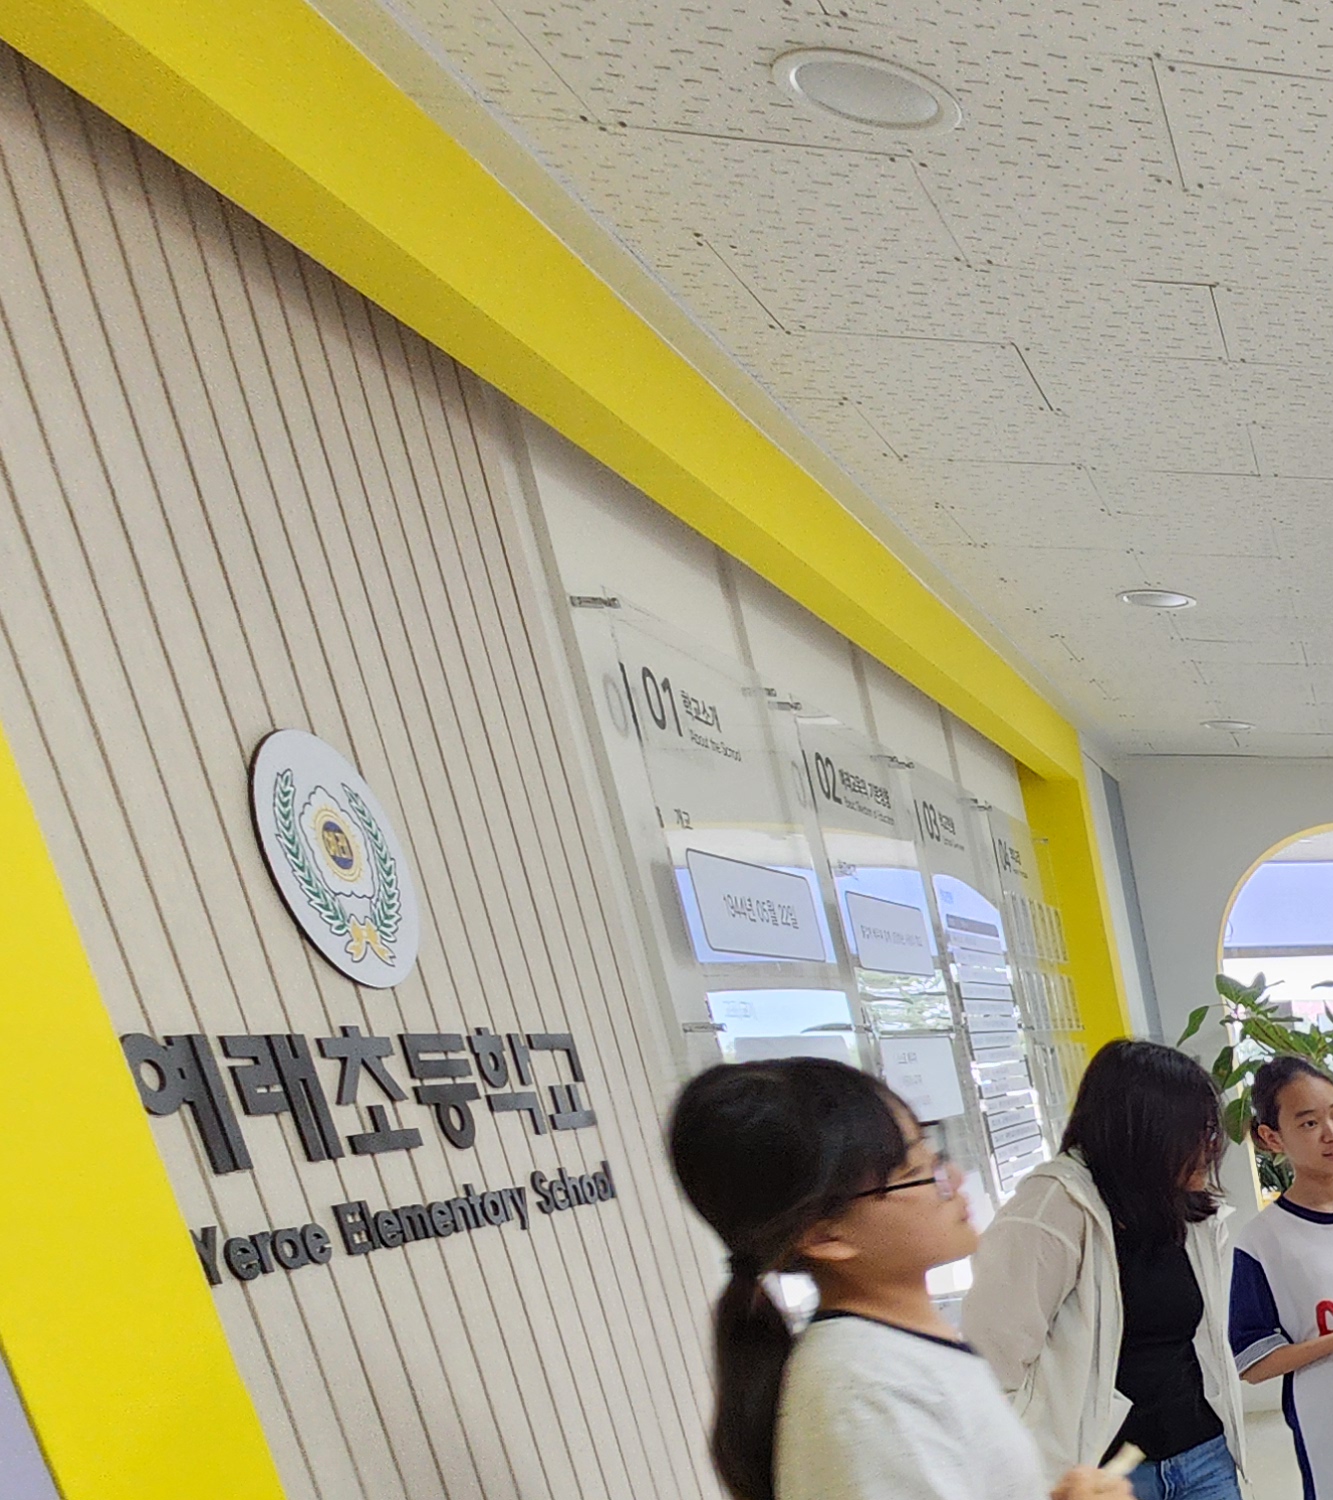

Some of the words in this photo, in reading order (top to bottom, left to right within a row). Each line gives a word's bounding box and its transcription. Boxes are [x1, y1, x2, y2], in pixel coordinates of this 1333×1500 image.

[641, 666, 683, 738] 01
[680, 689, 722, 733] 학교소개
[815, 752, 842, 805] 02
[923, 801, 941, 842] 03
[723, 894, 757, 923] 1944년
[756, 899, 779, 926] 05월
[778, 903, 800, 929] 22일
[120, 1025, 598, 1174] 예래초등학교
[190, 1222, 333, 1286] Yerae
[331, 1183, 530, 1256] Elementary
[531, 1160, 617, 1215] School
